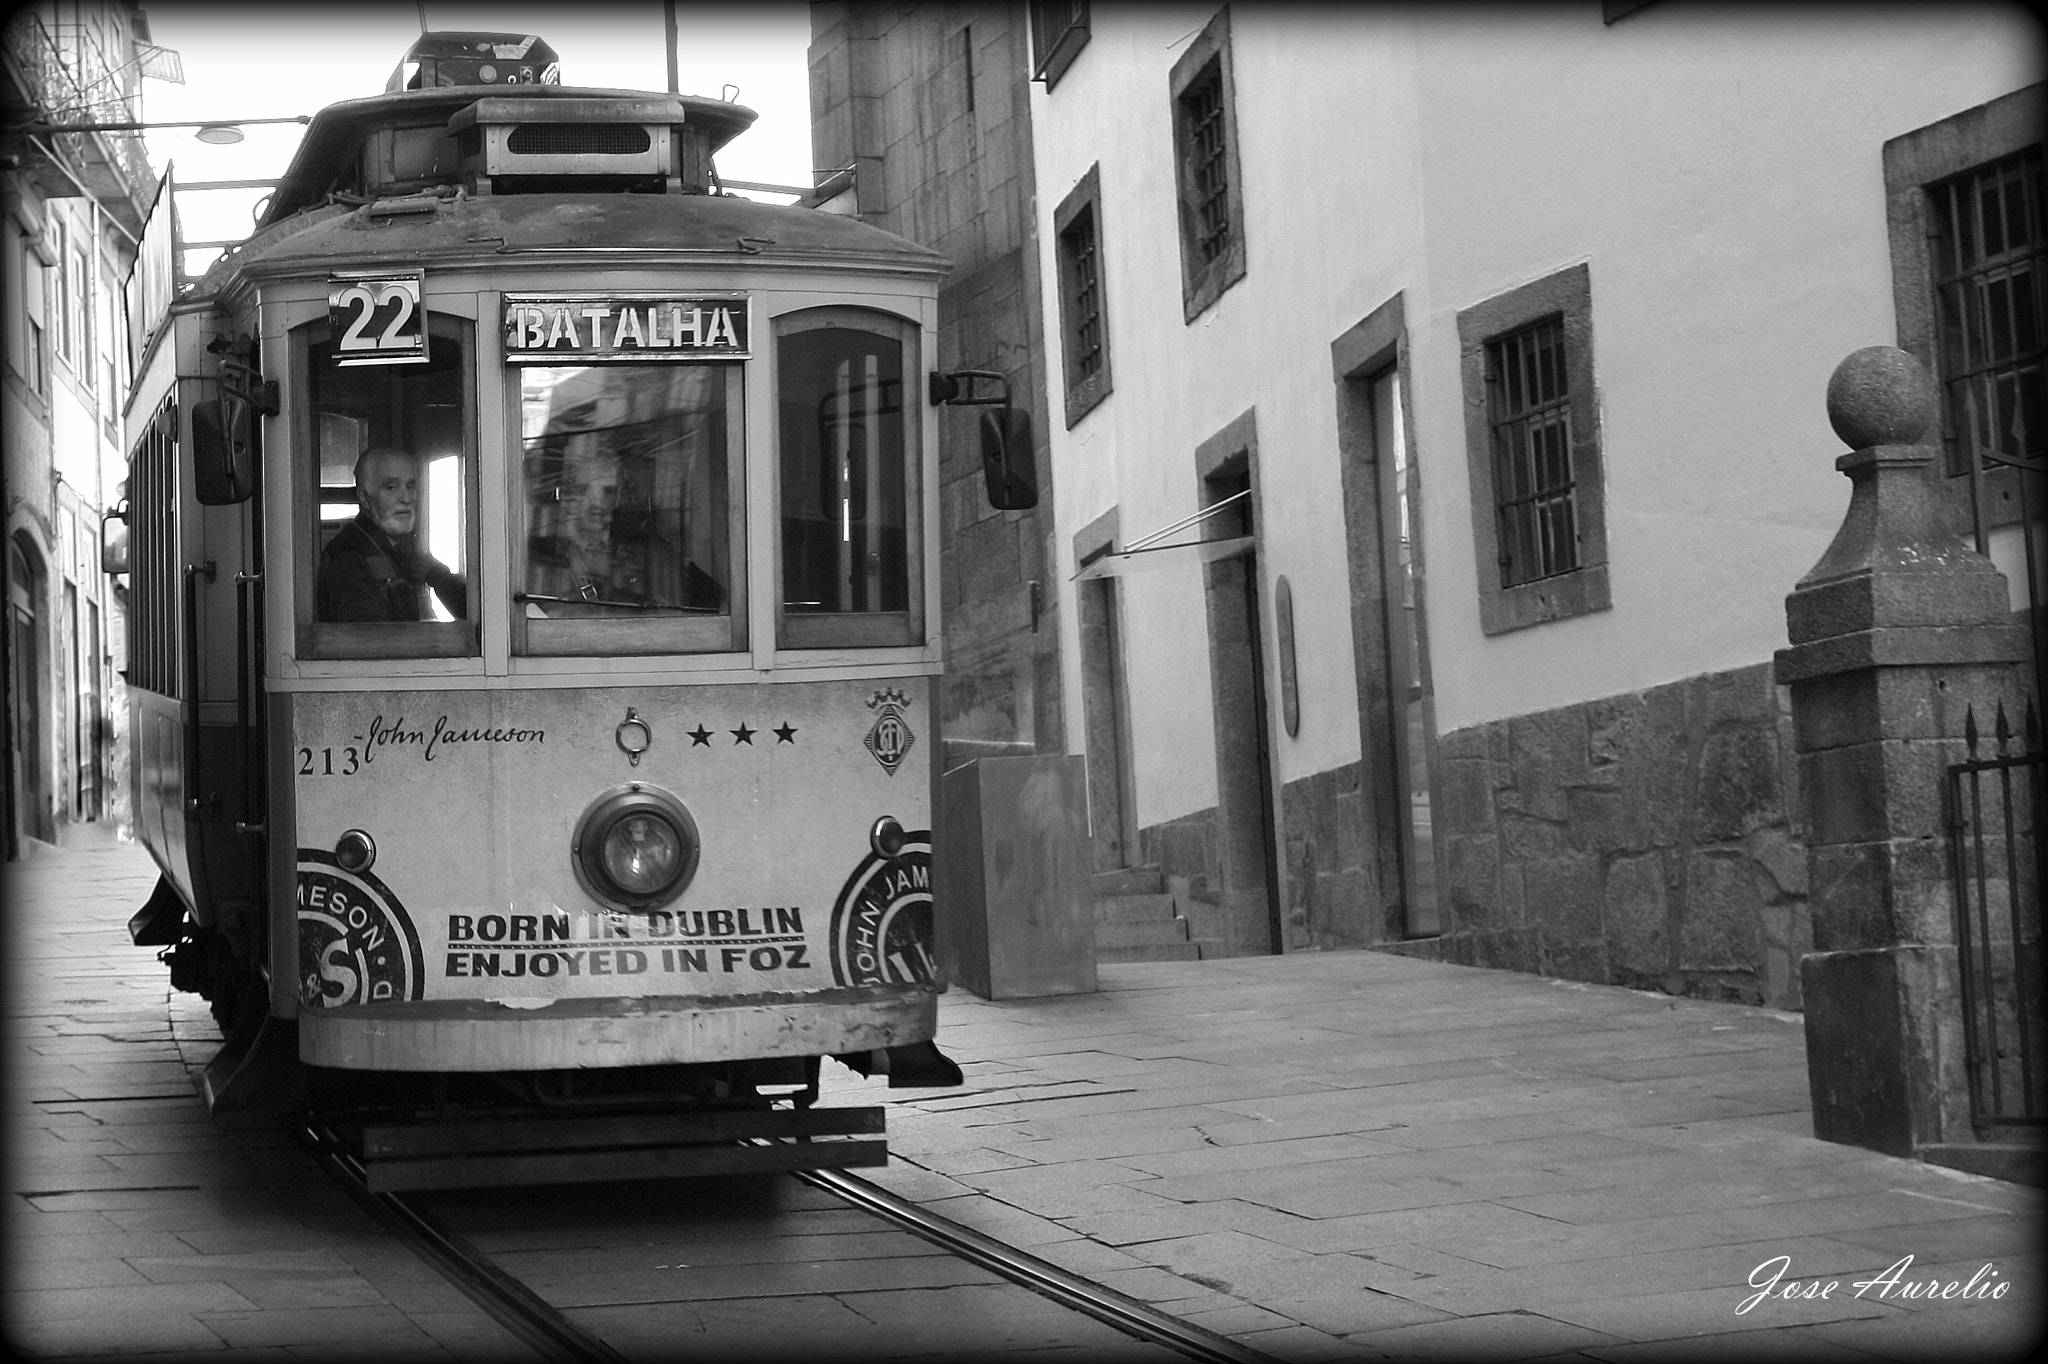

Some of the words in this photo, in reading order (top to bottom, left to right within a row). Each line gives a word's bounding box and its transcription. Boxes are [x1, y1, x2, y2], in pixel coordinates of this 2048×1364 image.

[337, 284, 415, 351] 22
[516, 306, 738, 349] BATALHA
[362, 715, 425, 763] John
[425, 715, 545, 762] Jameson
[298, 747, 360, 776] 213
[448, 913, 571, 942] BORN
[588, 912, 630, 940] IN
[647, 906, 805, 939] DUBLIN
[444, 949, 648, 978] ENJOYED
[661, 948, 709, 974] IN
[720, 944, 811, 974] FOZ
